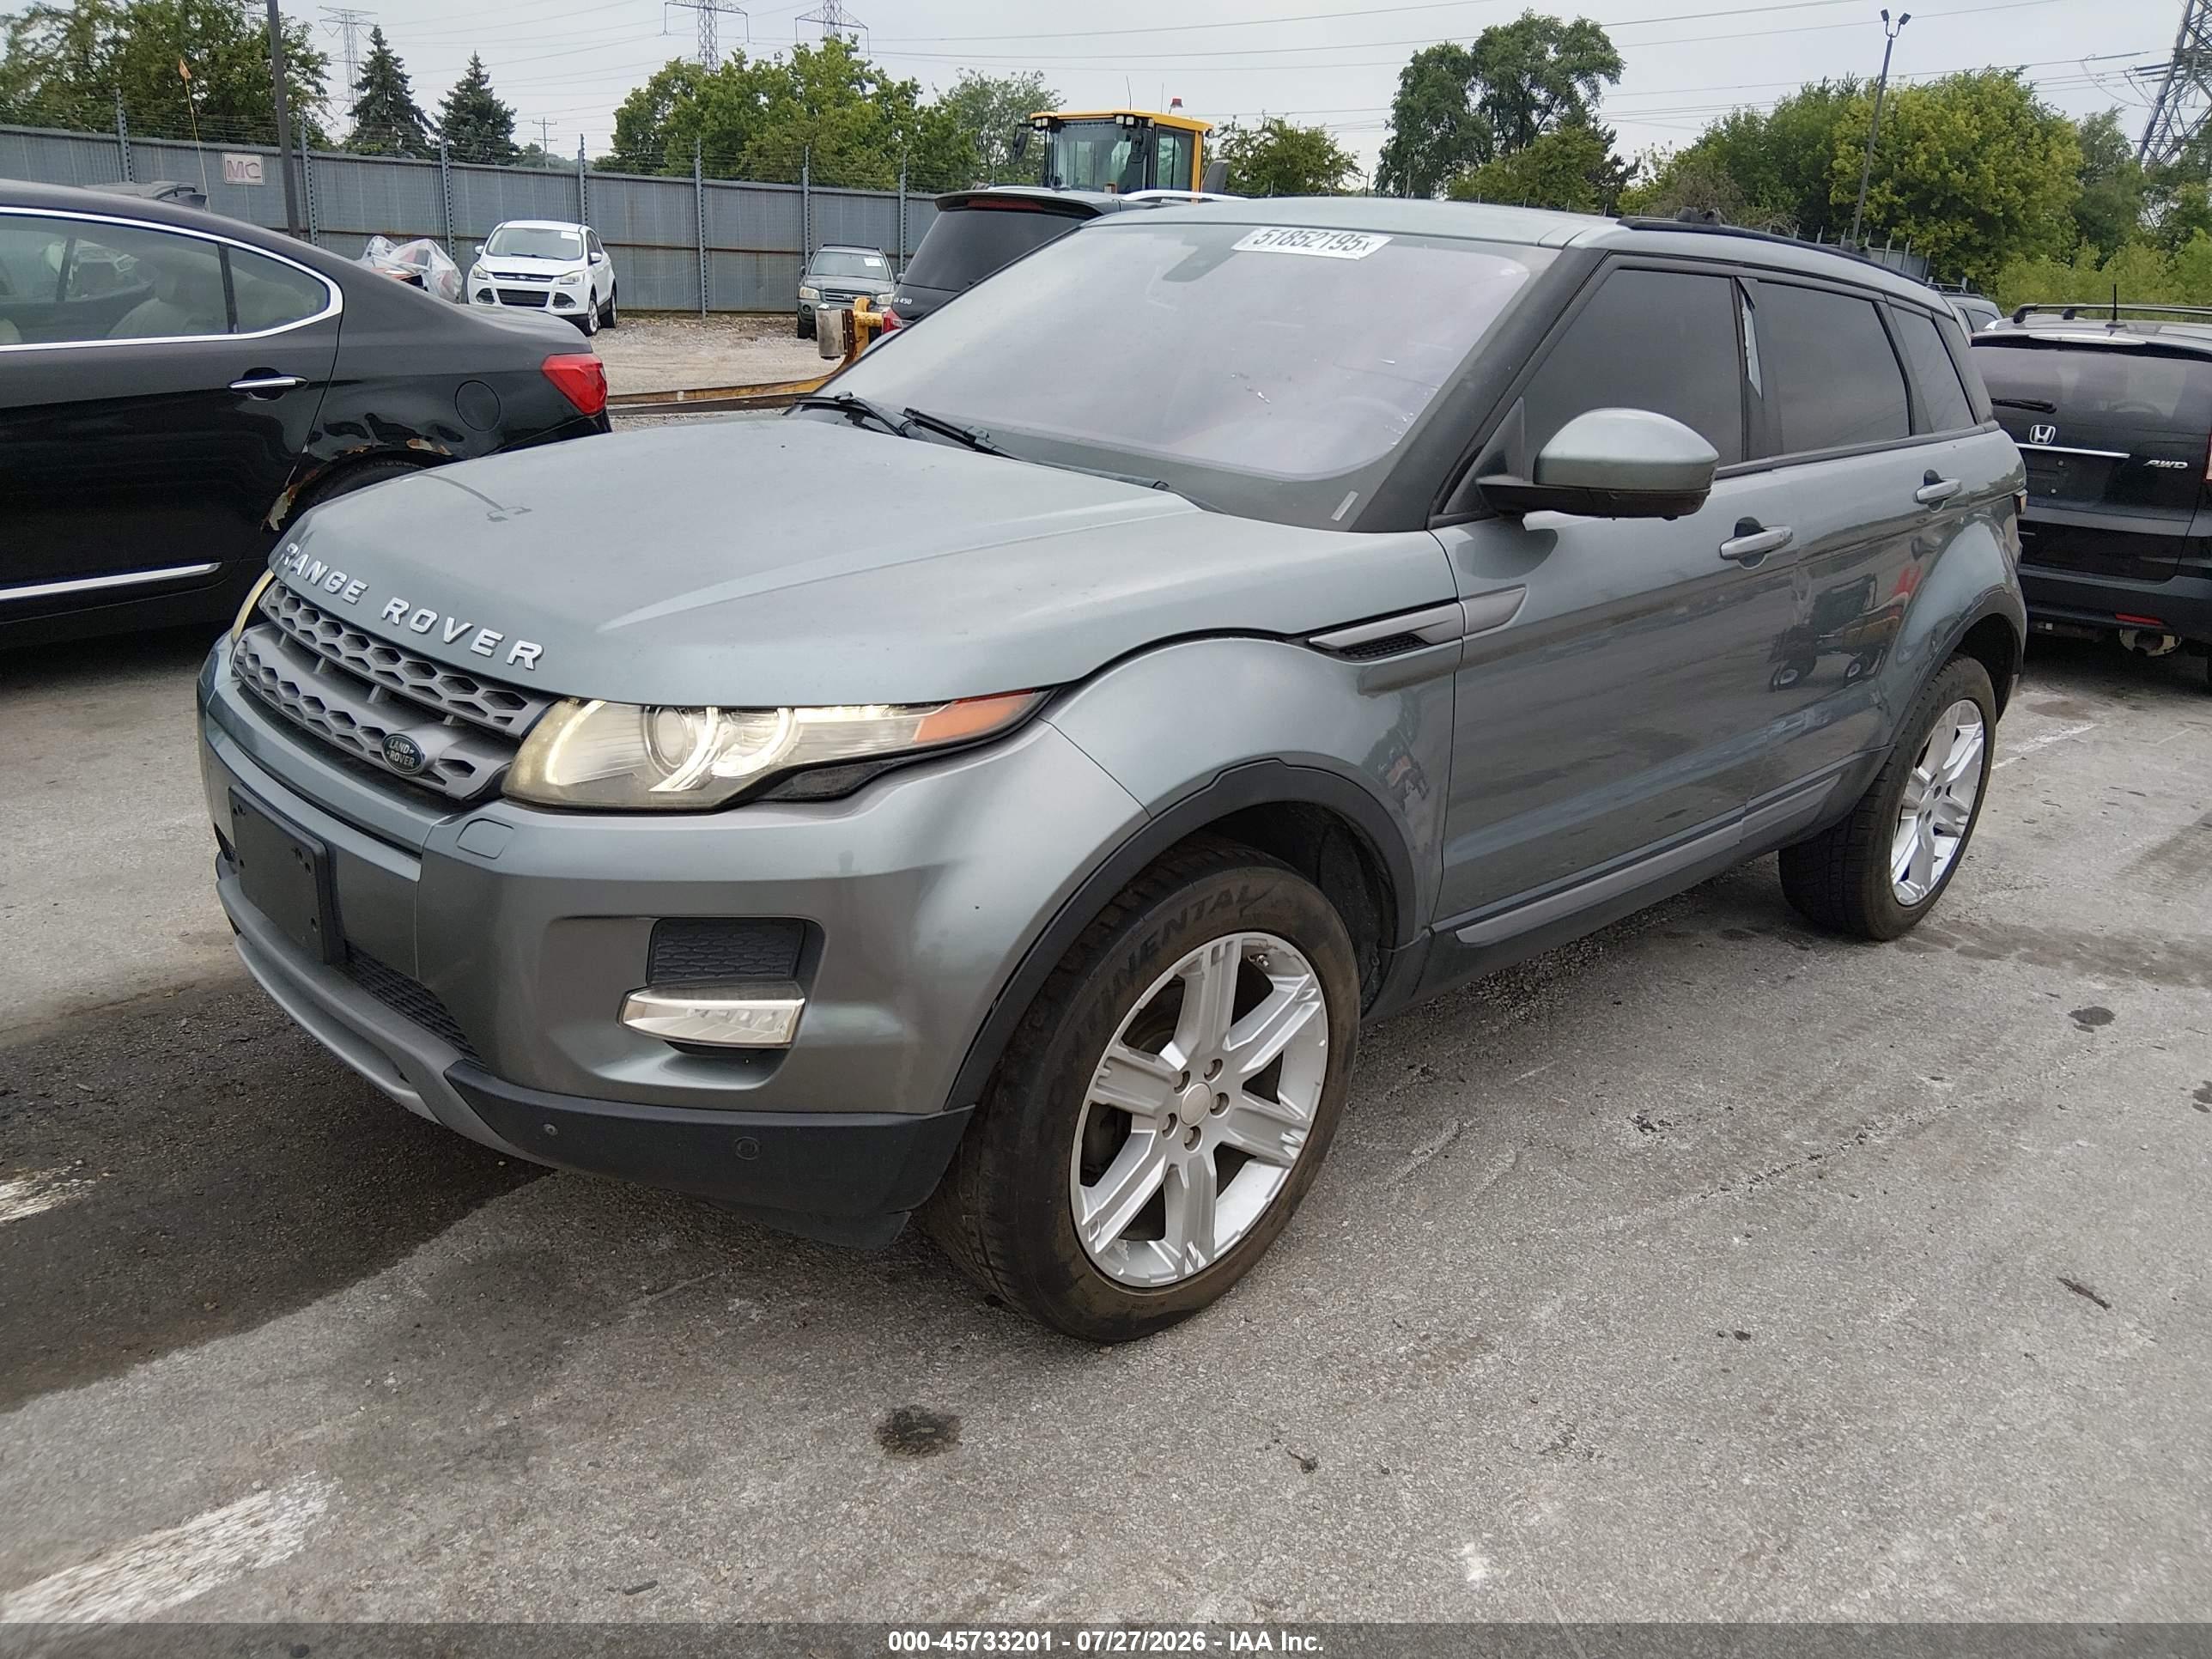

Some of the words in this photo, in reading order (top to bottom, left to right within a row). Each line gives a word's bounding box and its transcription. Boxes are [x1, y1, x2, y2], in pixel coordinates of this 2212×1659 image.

[227, 160, 262, 179] MC
[2143, 459, 2189, 469] AWD
[280, 542, 369, 605] RANGE
[380, 597, 544, 671] ROVER
[388, 738, 410, 755] LAND
[389, 750, 416, 768] ROVER
